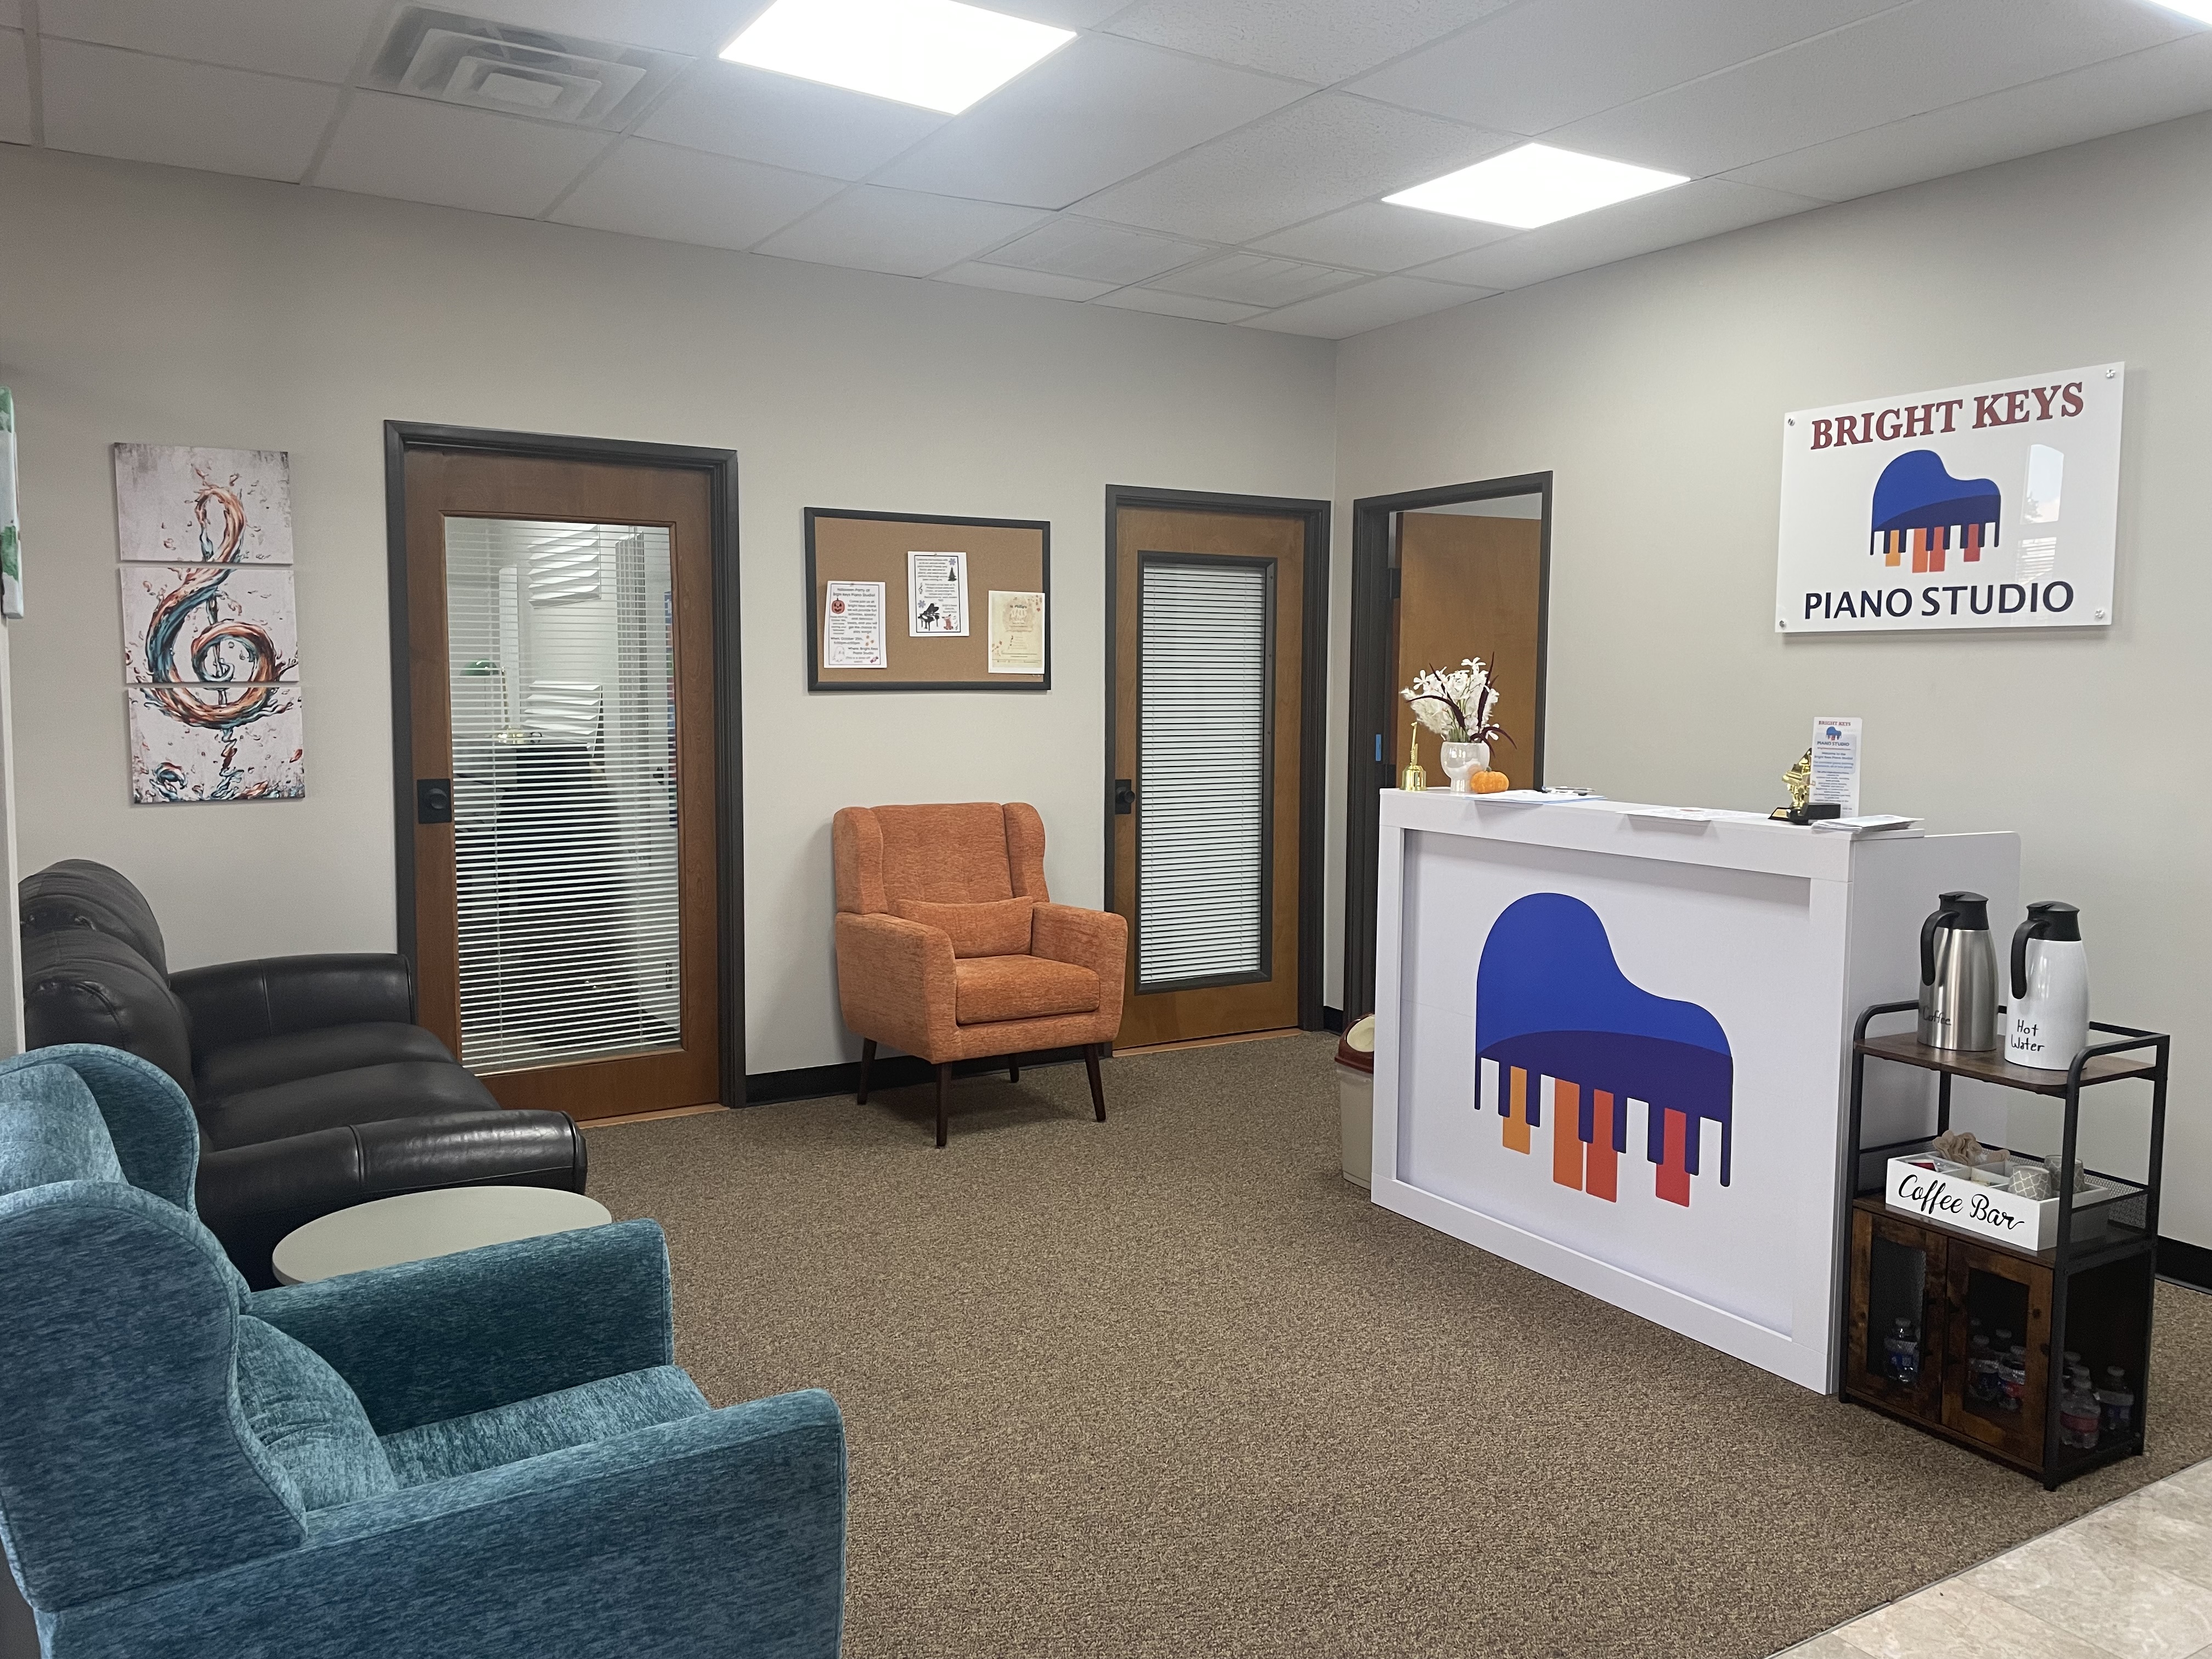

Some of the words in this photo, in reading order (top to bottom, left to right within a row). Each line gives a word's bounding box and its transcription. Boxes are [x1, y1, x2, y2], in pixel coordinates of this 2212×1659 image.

[1810, 398, 1963, 450] BRIGHT
[1972, 381, 2084, 429] KEYS
[1805, 588, 1912, 619] PIANO
[1921, 580, 2074, 617] STUDIO
[1923, 1005, 1952, 1026] Coffee
[2017, 1019, 2040, 1037] Hot
[2011, 1034, 2045, 1052] Water
[1898, 1174, 1963, 1215] Coffee
[1970, 1193, 2025, 1229] Bar
